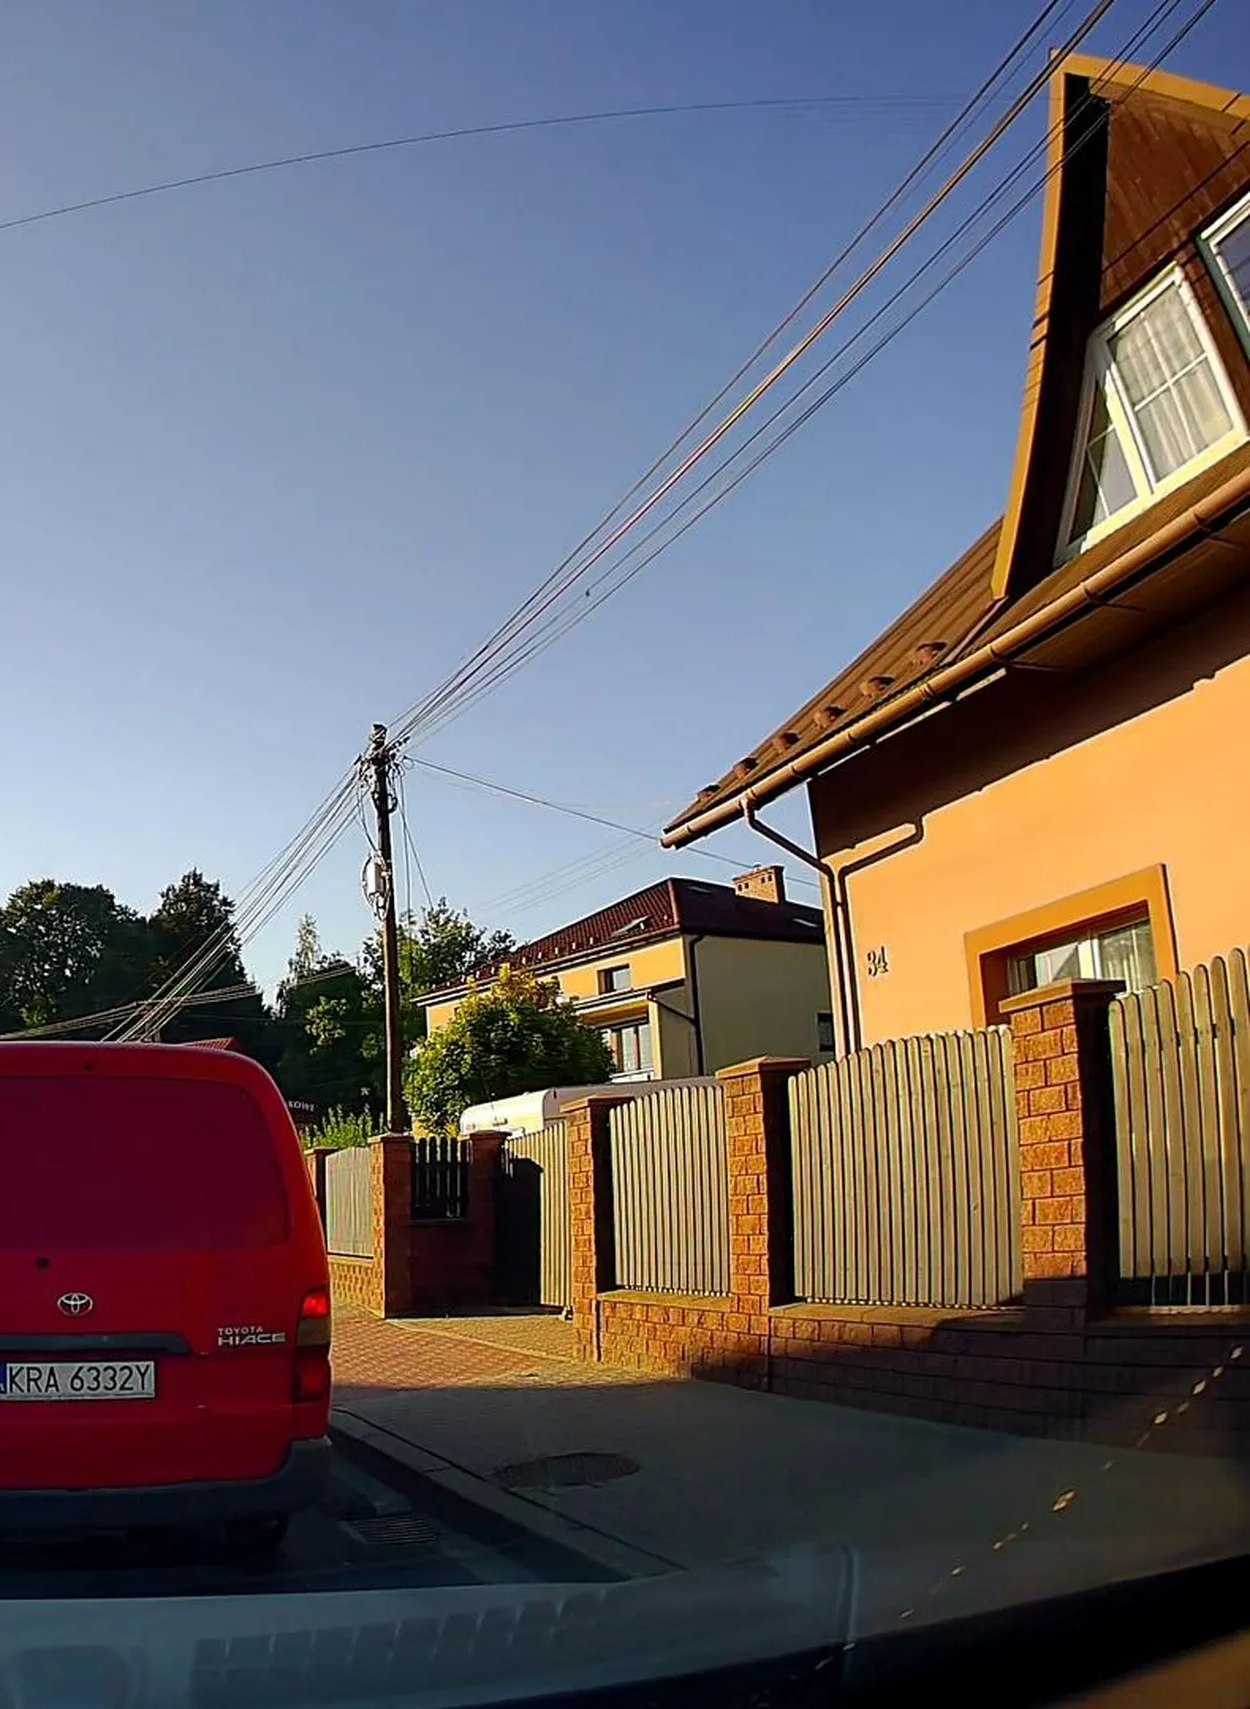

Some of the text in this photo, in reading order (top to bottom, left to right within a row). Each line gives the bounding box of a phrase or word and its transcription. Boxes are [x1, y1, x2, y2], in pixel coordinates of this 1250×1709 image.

[867, 946, 889, 977] 34
[217, 1326, 264, 1336] TOYOTA
[217, 1333, 286, 1346] HIACE
[8, 1366, 60, 1393] KRA
[69, 1364, 151, 1393] 6332Y
